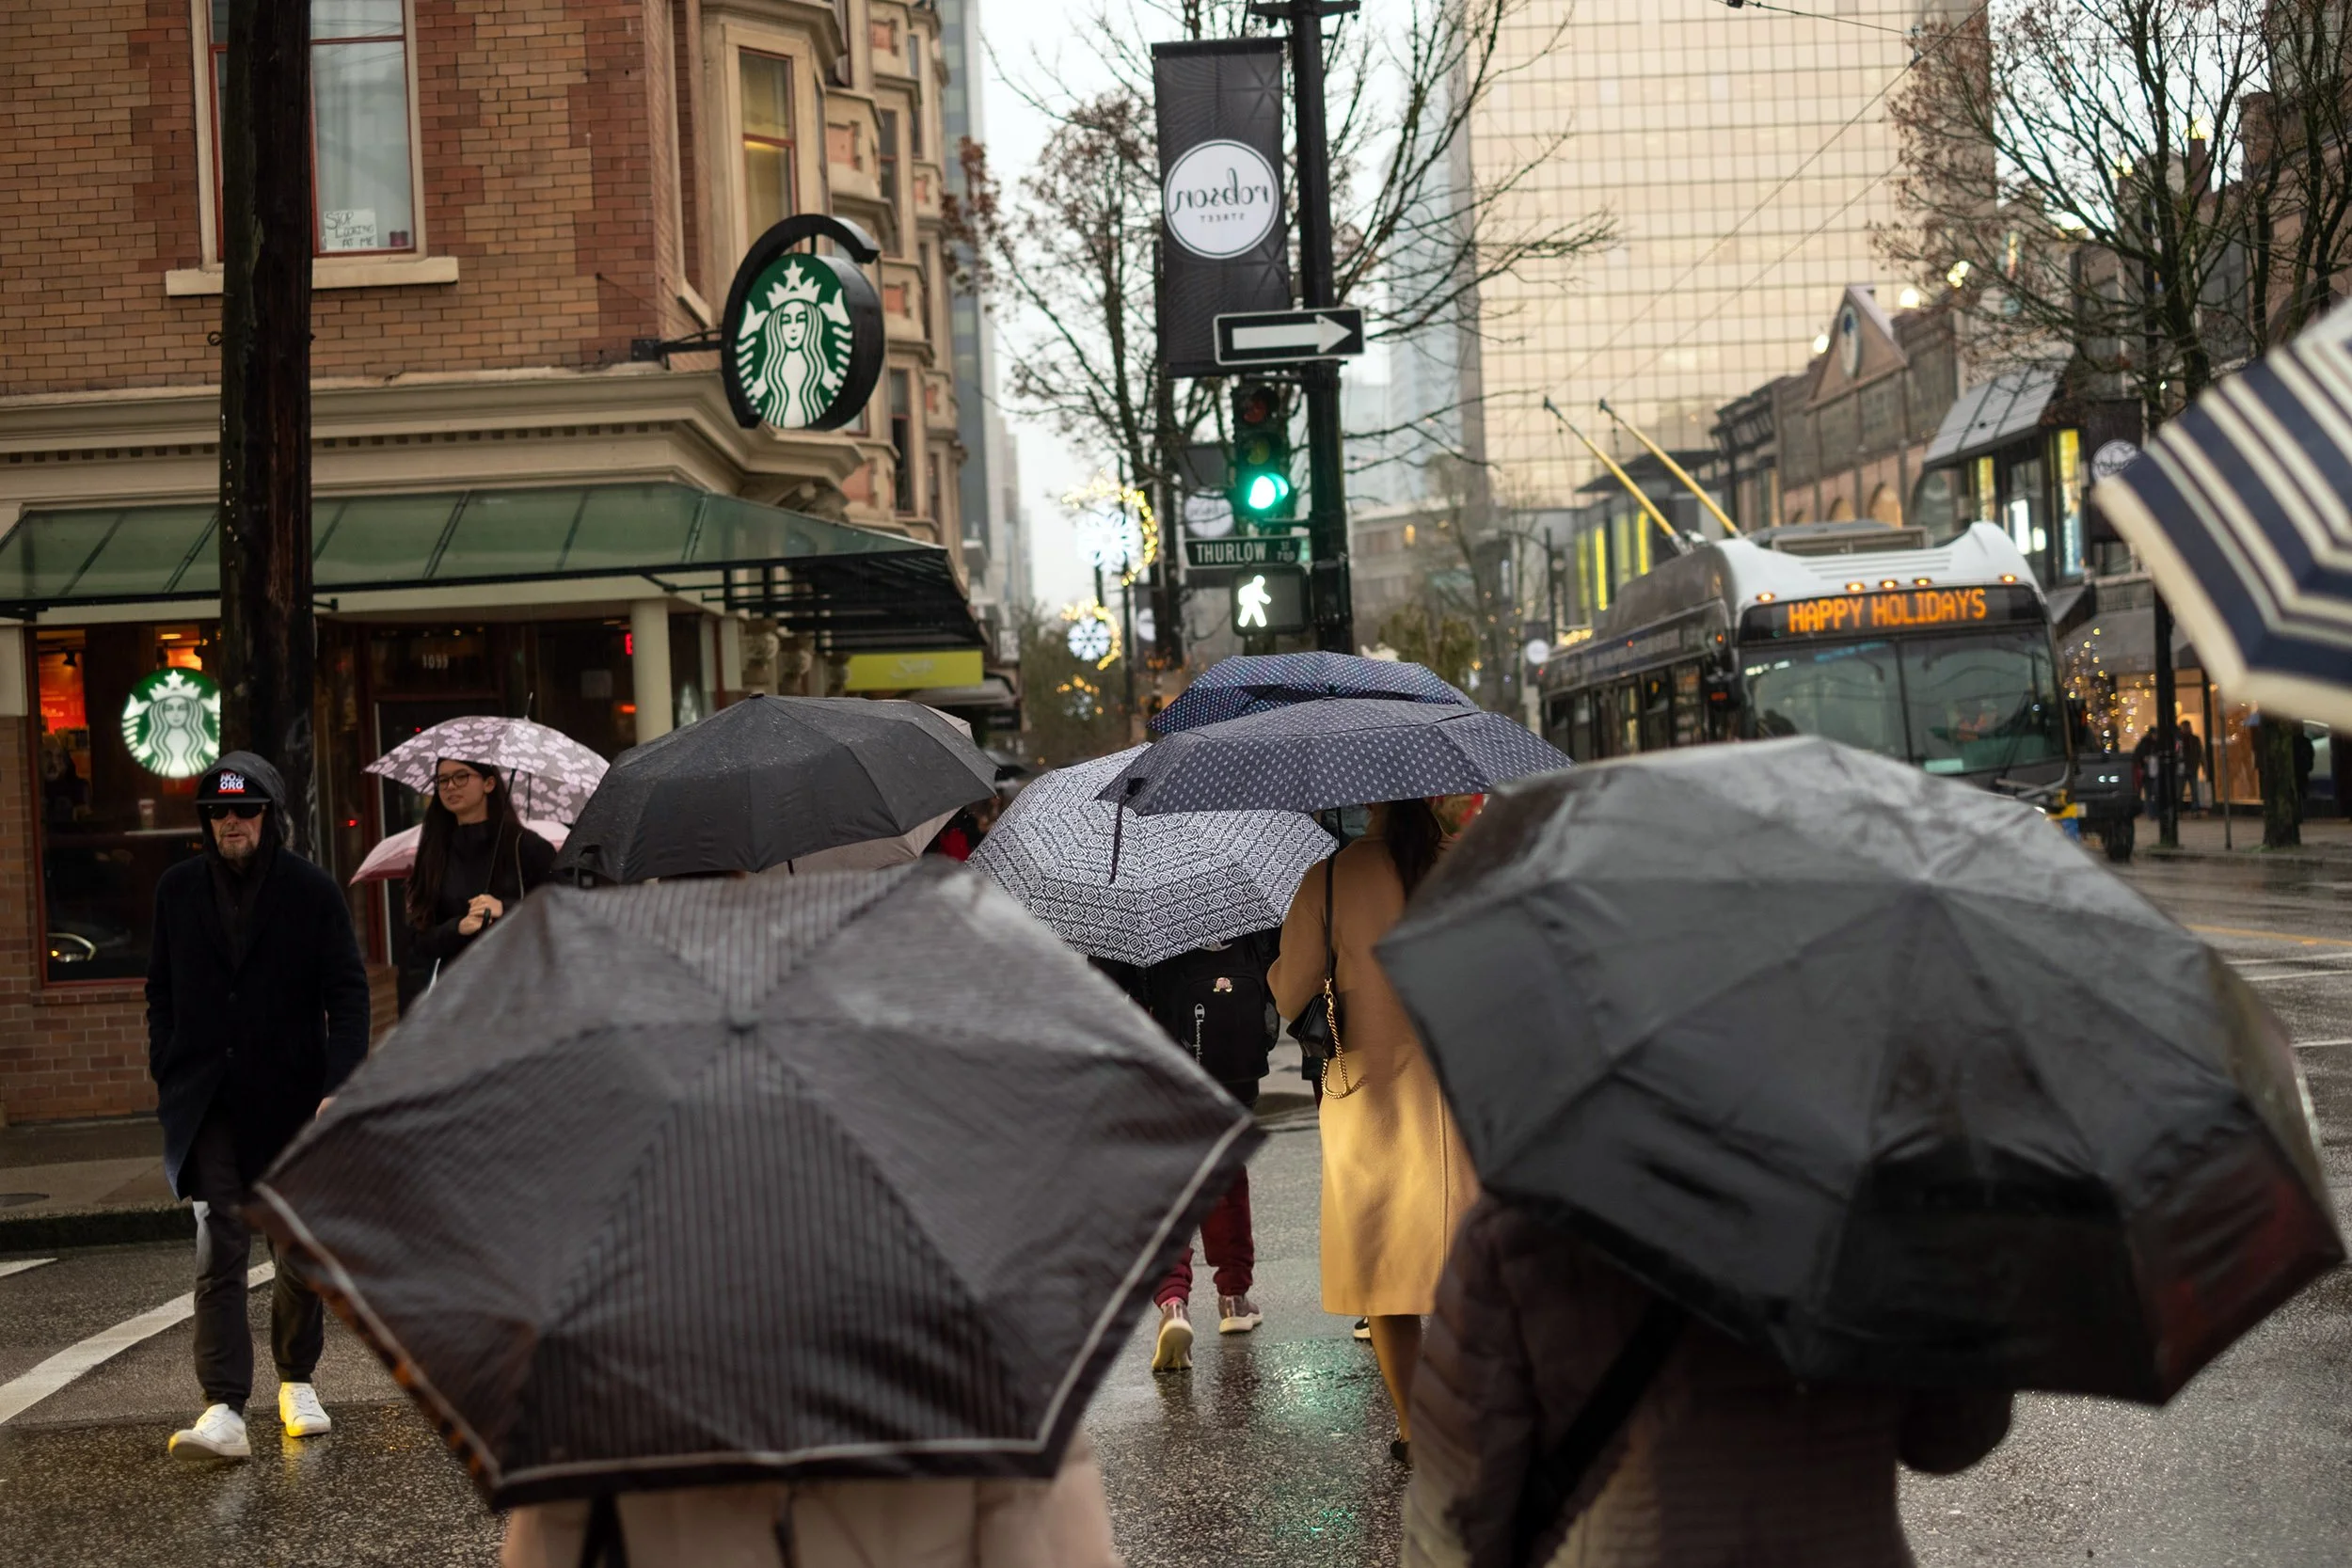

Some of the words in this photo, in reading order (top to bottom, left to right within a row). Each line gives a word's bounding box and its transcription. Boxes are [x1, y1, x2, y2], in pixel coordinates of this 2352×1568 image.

[326, 210, 354, 230] STOP
[335, 224, 374, 239] LOOKING
[342, 237, 354, 248] AT
[359, 236, 374, 247] ME
[1196, 542, 1266, 563] THURLOW
[1788, 596, 1864, 633] HAPPY
[1871, 587, 1987, 627] HOLIDAYS
[220, 781, 245, 790] ORG
[1192, 1003, 1205, 1065] Champio
